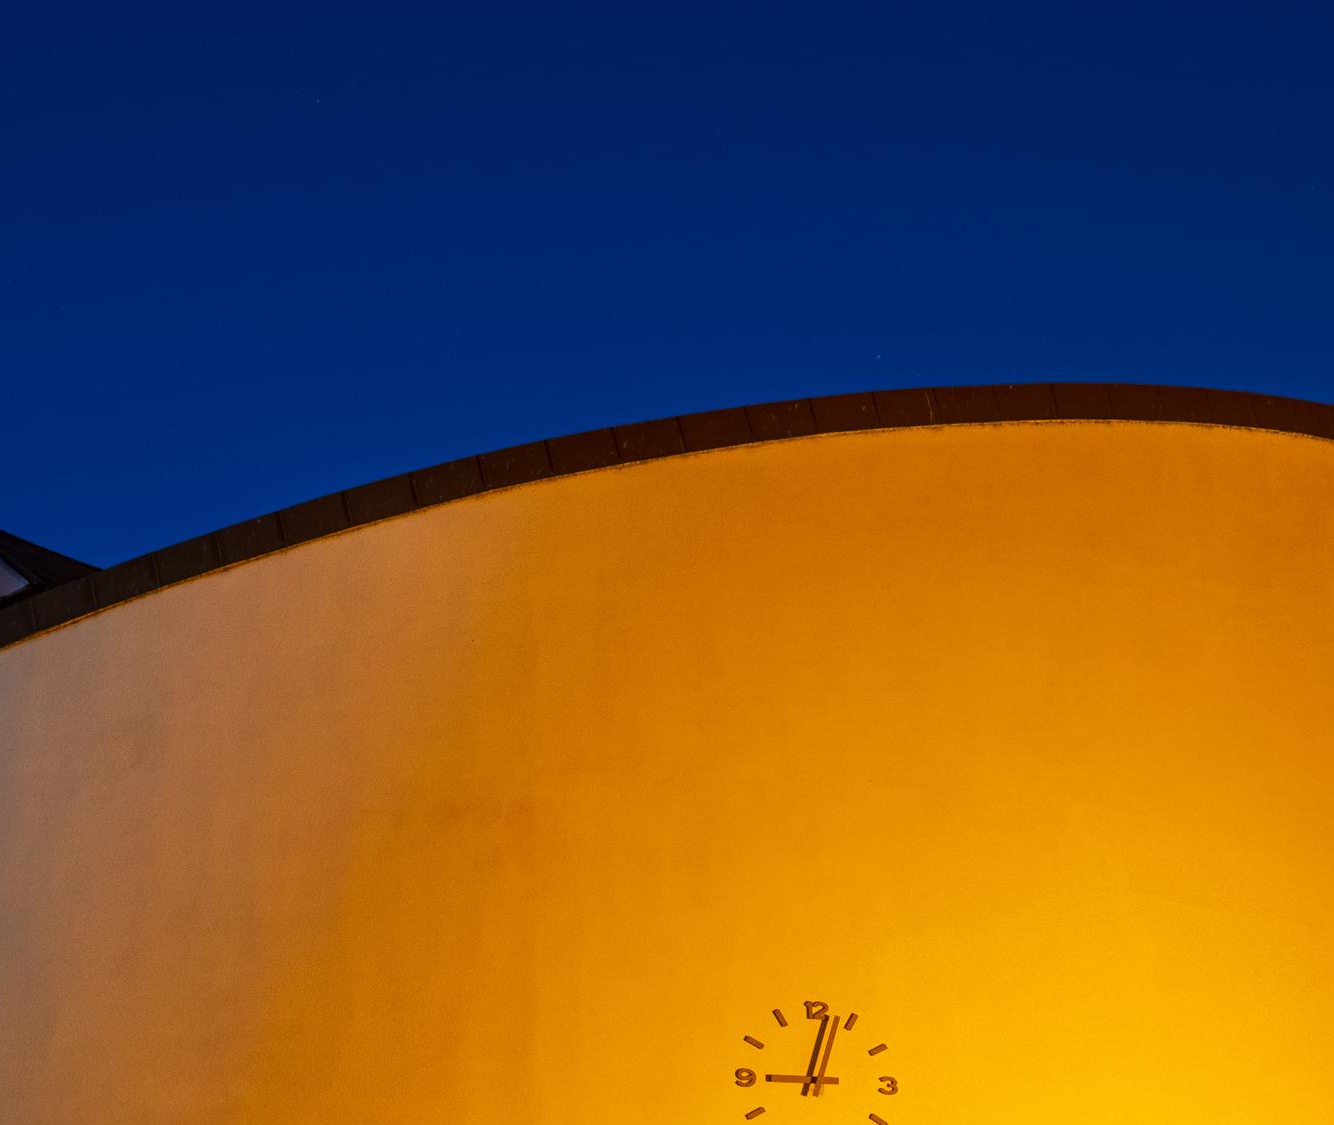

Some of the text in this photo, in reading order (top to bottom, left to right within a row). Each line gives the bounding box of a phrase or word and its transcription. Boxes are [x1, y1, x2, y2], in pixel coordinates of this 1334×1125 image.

[803, 1000, 829, 1020] 12
[734, 1067, 757, 1088] 9
[877, 1076, 899, 1095] 3
